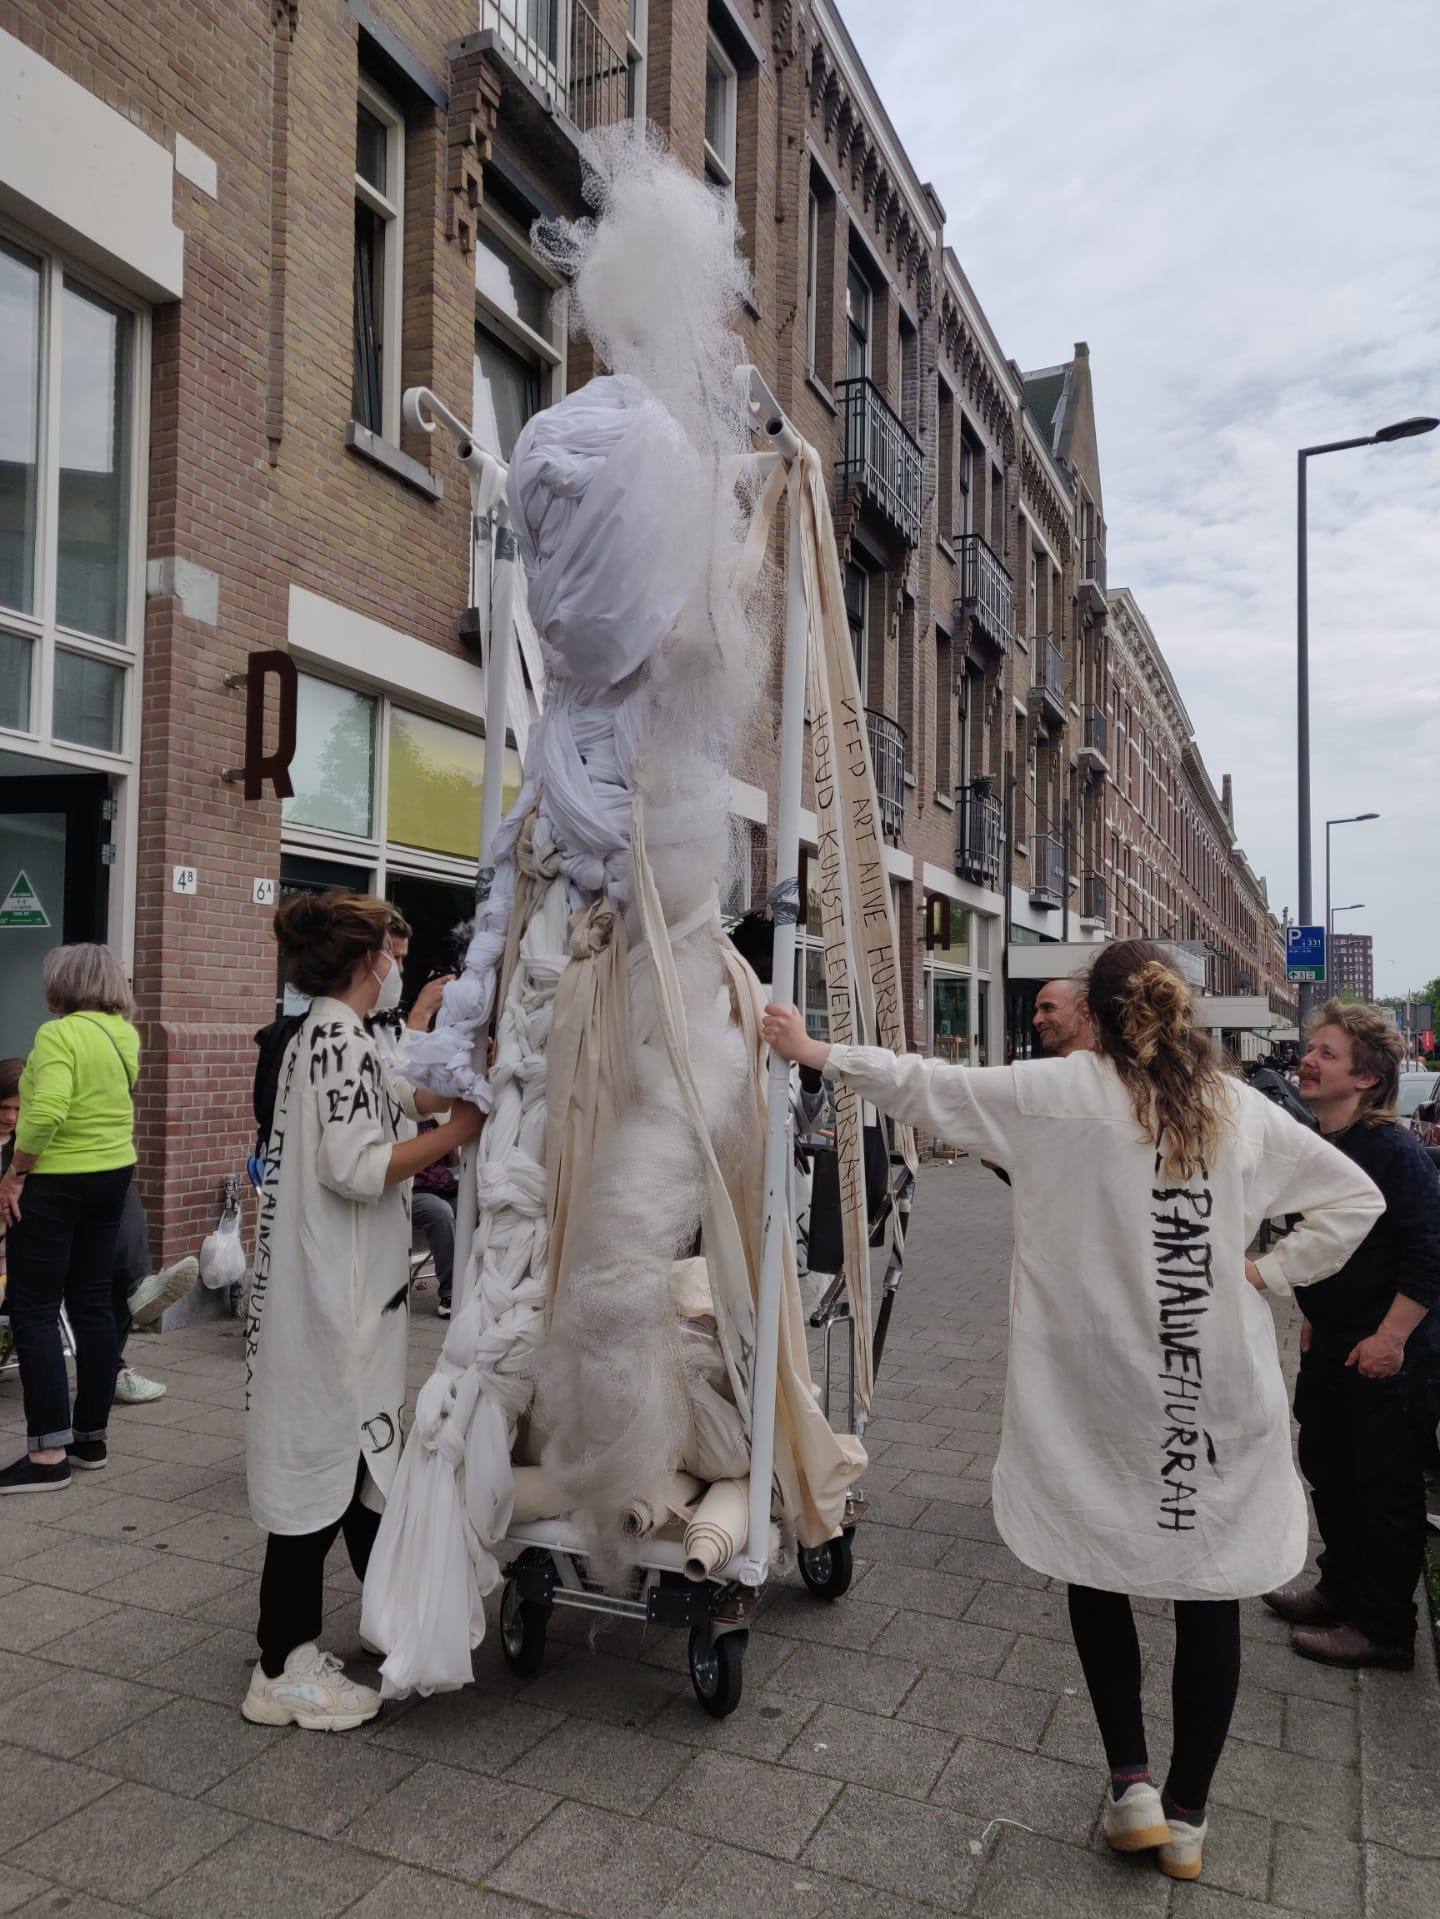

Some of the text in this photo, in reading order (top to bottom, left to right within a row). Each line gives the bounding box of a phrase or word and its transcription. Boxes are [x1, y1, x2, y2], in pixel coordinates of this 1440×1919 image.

[244, 649, 298, 801] R
[811, 711, 834, 810] HOUD
[852, 798, 877, 845] ART
[818, 828, 845, 928] KUNST
[858, 861, 887, 929] ALIVE
[925, 892, 951, 951] A
[1288, 928, 1302, 946] P
